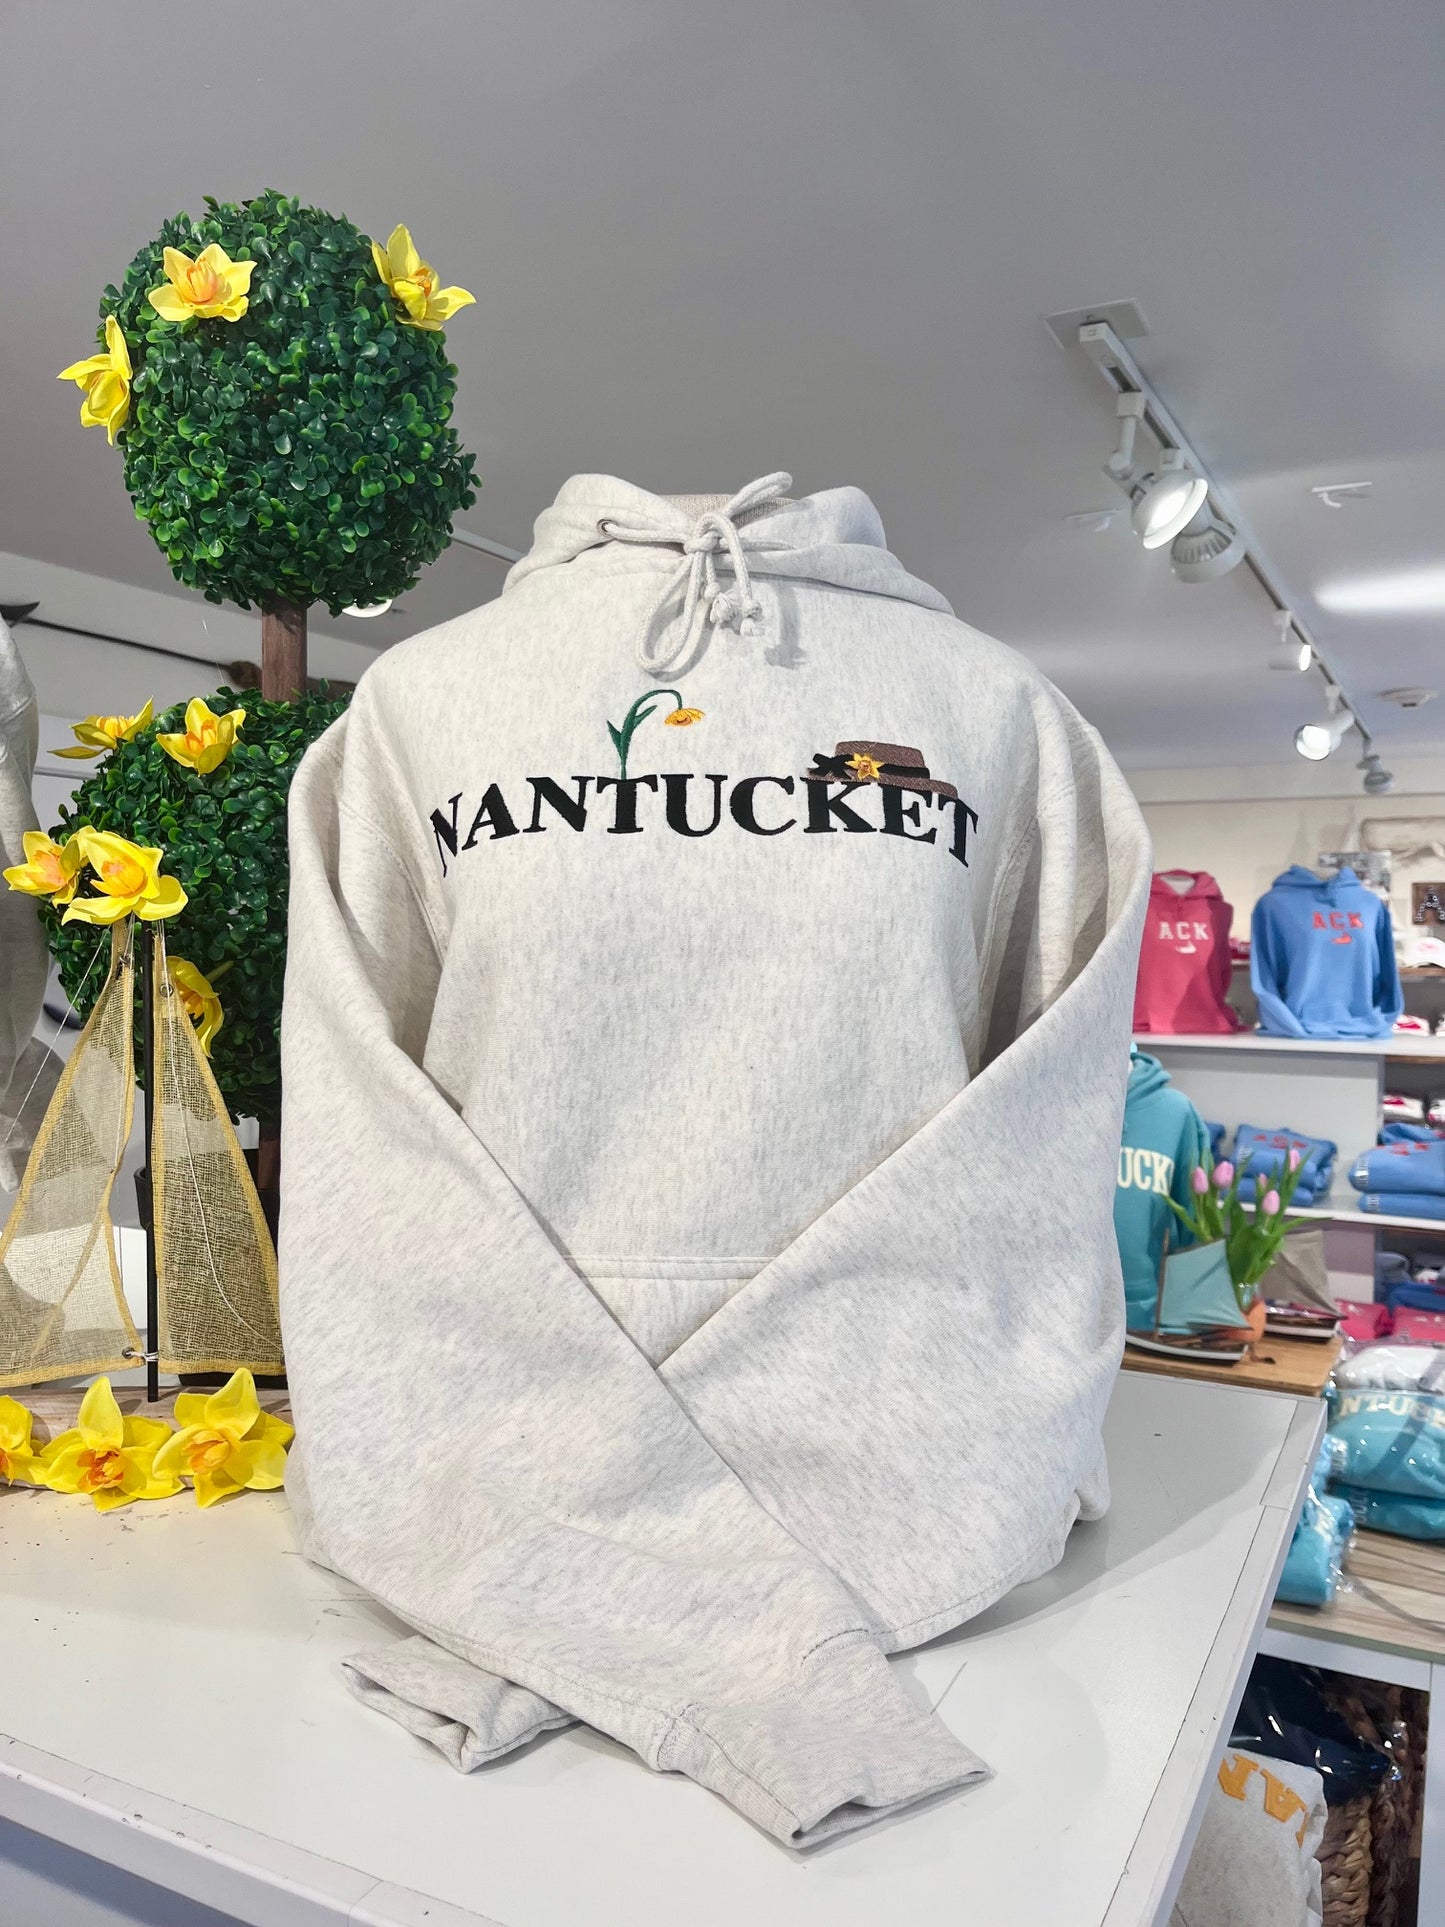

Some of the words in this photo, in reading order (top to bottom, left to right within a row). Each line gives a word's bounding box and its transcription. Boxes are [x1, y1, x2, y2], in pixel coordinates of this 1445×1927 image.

[430, 773, 979, 878] NANTUCKET
[1158, 920, 1209, 940] ACK
[1312, 911, 1364, 930] ACK
